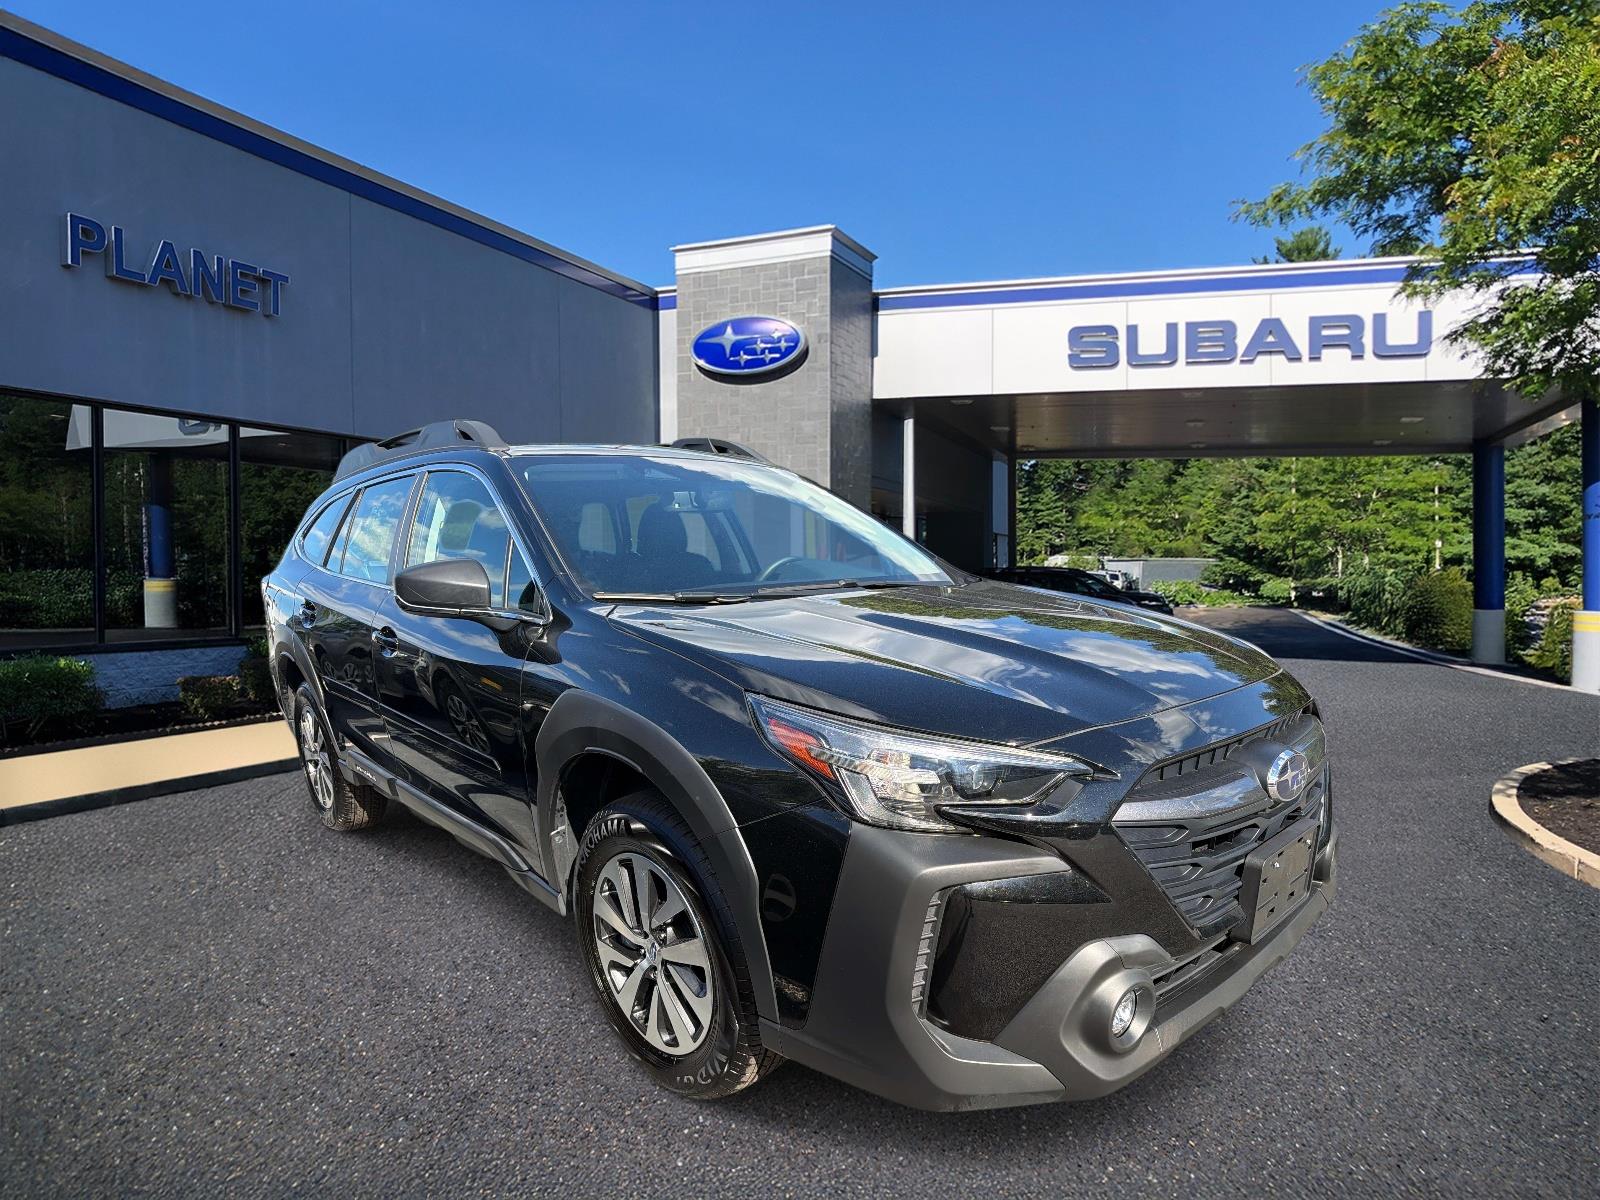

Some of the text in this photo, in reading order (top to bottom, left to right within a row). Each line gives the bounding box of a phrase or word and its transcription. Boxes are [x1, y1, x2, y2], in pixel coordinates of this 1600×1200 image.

[65, 212, 290, 317] PLANET
[1067, 310, 1433, 369] SUBARU
[579, 818, 628, 871] OKOHAMA
